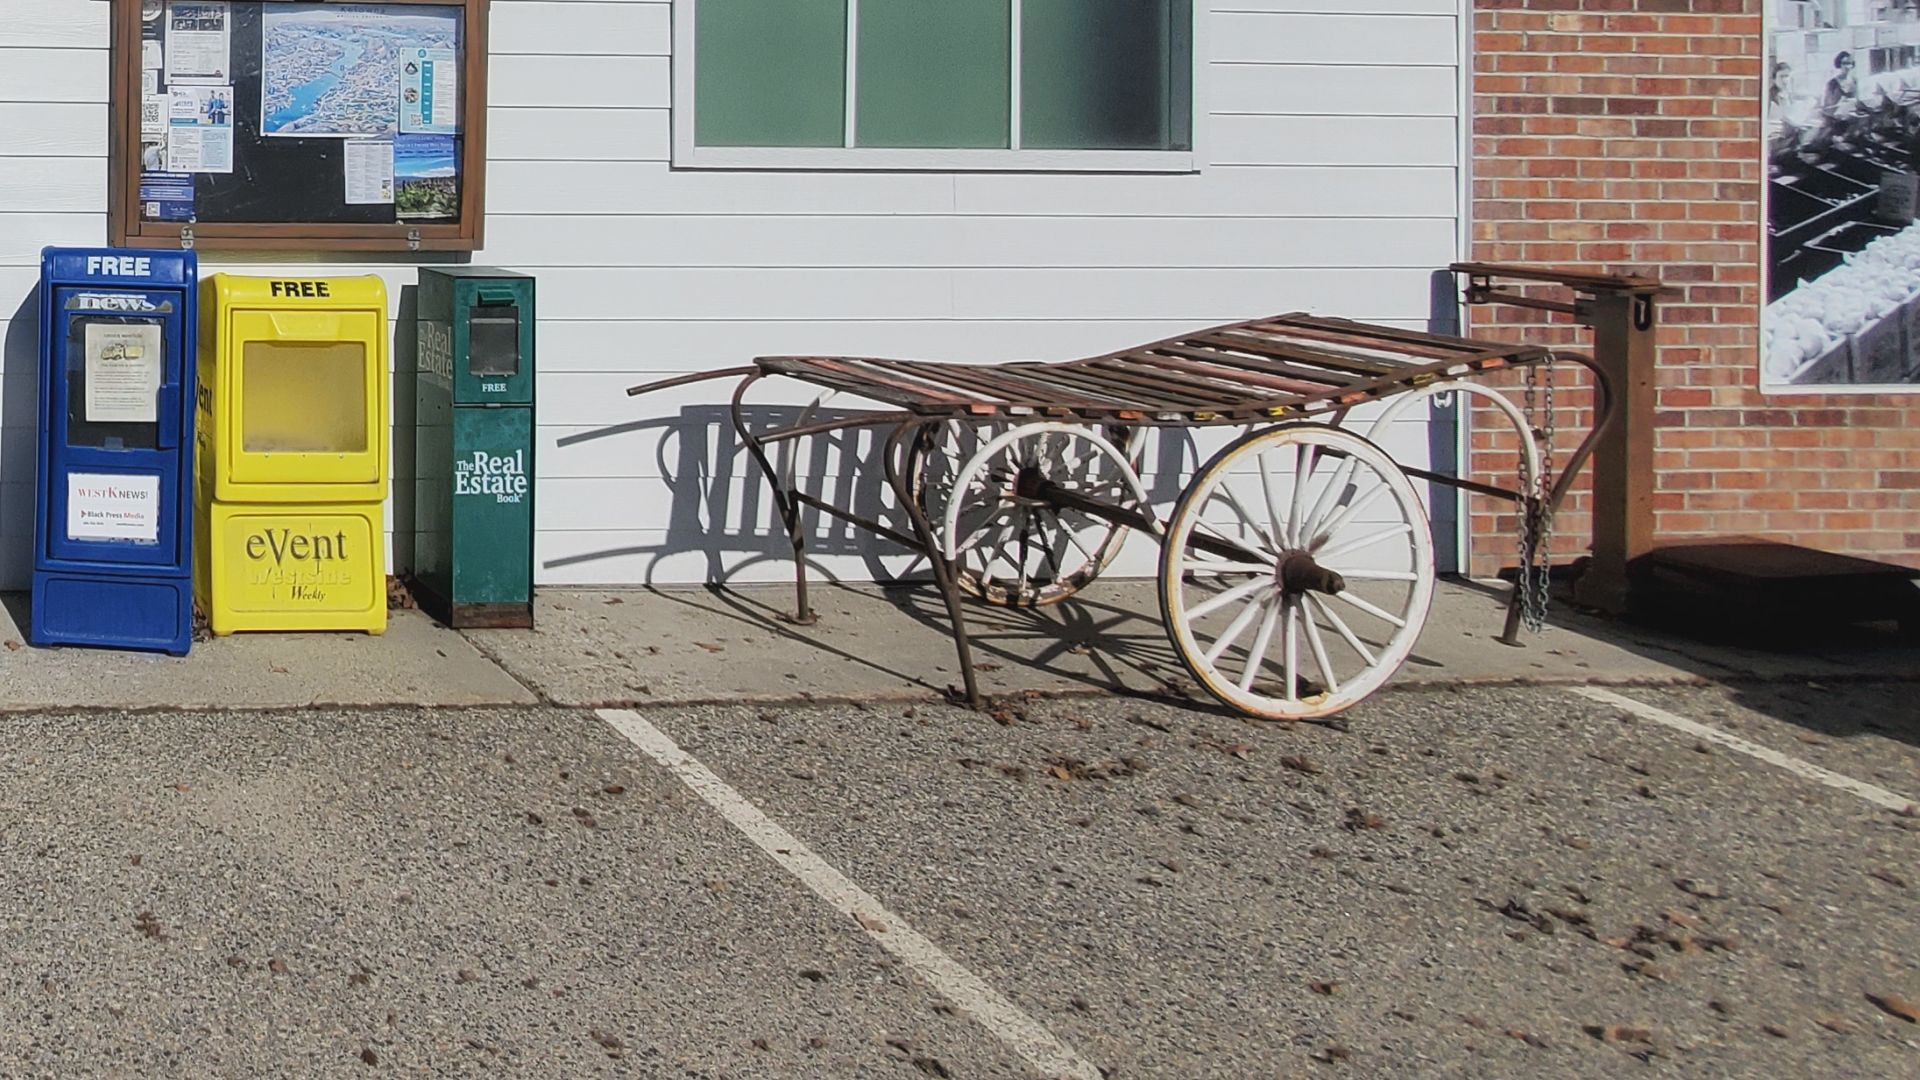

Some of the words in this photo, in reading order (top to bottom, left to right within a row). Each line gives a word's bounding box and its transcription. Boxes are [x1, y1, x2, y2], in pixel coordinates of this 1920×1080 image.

[87, 256, 151, 276] FREE
[270, 281, 330, 297] FREE
[427, 321, 453, 355] Real
[418, 341, 453, 379] Estate
[482, 383, 507, 392] FREE
[456, 460, 475, 471] The
[473, 449, 524, 475] Real
[455, 471, 528, 495] Estate
[105, 511, 123, 519] Press
[123, 512, 145, 520] Media
[290, 585, 326, 602] Weekly
